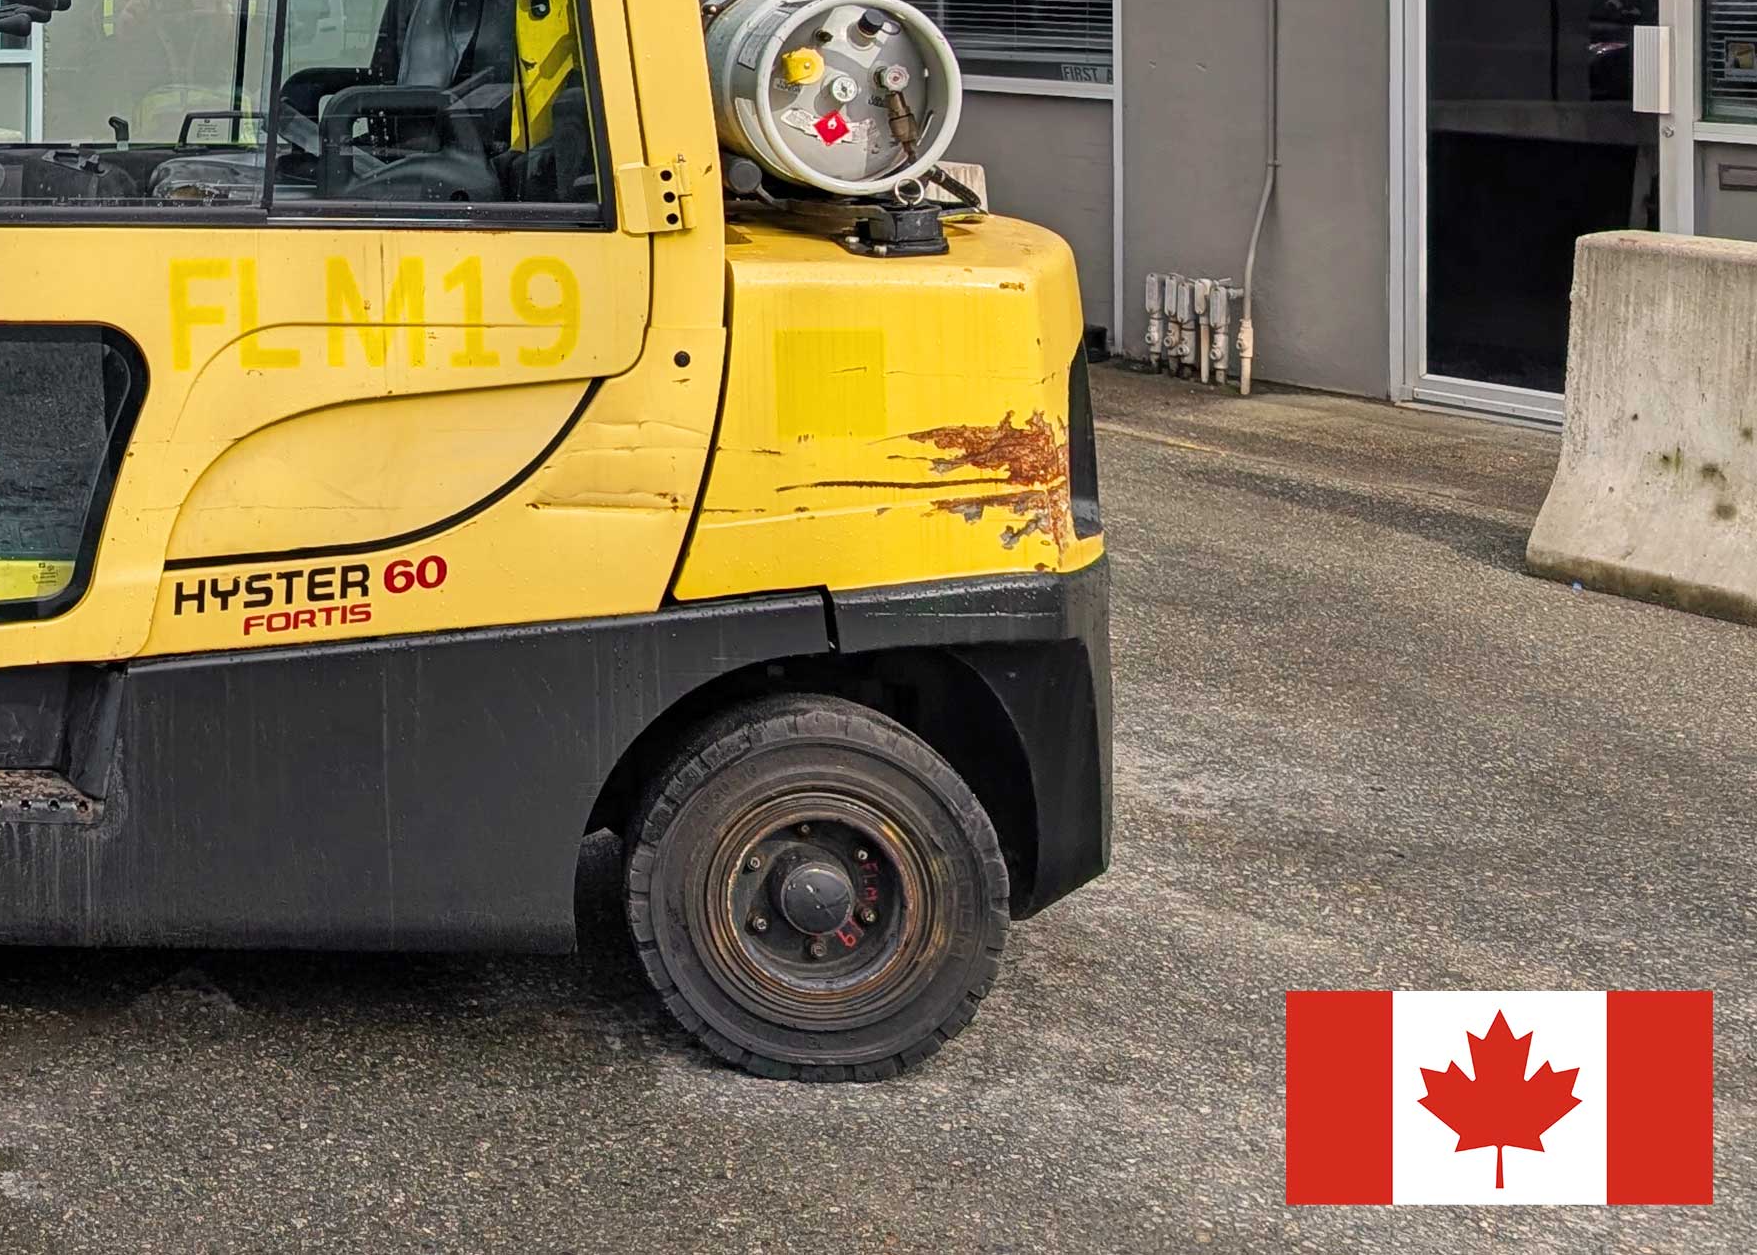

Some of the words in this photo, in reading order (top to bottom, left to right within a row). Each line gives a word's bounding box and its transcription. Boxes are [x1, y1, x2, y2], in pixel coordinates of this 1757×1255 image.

[1063, 66, 1098, 82] FIRST
[173, 563, 371, 616] HYSTER
[383, 554, 448, 594] 60
[243, 603, 372, 636] FORTIS
